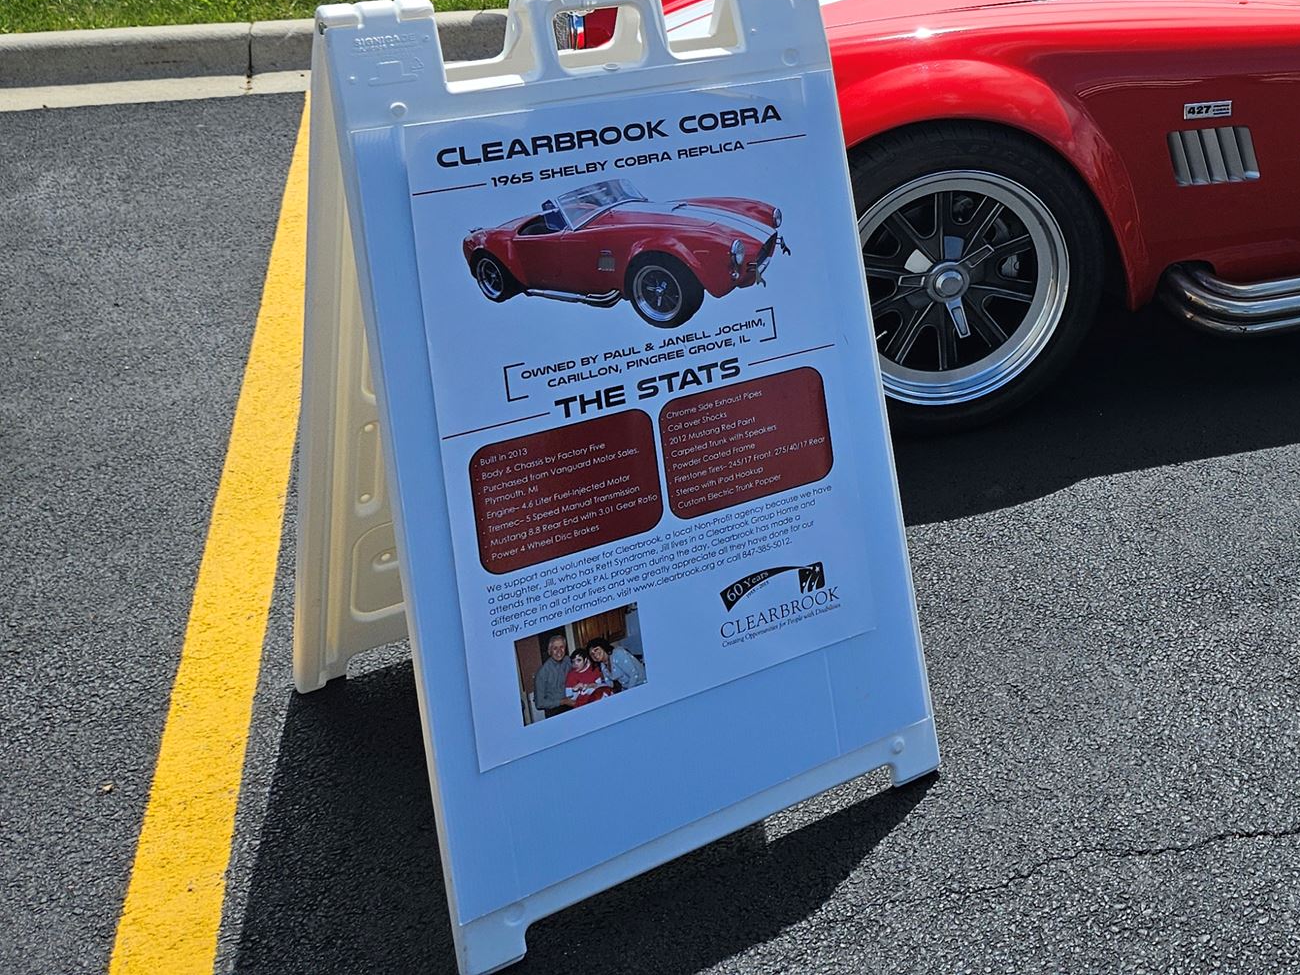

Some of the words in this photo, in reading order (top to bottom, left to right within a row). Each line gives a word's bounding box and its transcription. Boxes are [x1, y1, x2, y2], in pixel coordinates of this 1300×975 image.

[1188, 105, 1211, 115] 427
[436, 119, 669, 167] CLEARBROOK
[678, 104, 781, 133] COBRA
[491, 171, 534, 187] 1965
[539, 160, 608, 180] SHELBY
[614, 151, 672, 168] COBRA
[677, 140, 744, 159] REPLICA
[521, 360, 576, 379] OWNED
[580, 354, 598, 366] BY
[603, 346, 641, 361] PAUL
[644, 342, 654, 351] &
[658, 330, 711, 349] JANELL
[714, 318, 765, 336] JOCHIM,
[547, 364, 622, 387] CARILLON,
[626, 348, 684, 370] PINGREE
[688, 337, 735, 354] GROVE,
[739, 334, 751, 343] IL
[554, 384, 626, 418] THE
[636, 357, 740, 400] STATS
[666, 407, 696, 419] Chrome
[697, 402, 713, 411] Side
[714, 394, 741, 407] Exhaust
[743, 390, 762, 399] Pipes
[667, 422, 682, 432] Coil
[683, 418, 701, 428] over
[701, 412, 727, 423] Shocks
[669, 434, 686, 445] 2012
[688, 426, 720, 440] Mustang
[720, 421, 736, 431] Red
[737, 416, 755, 427] Paint
[670, 442, 707, 457] Carpeted
[708, 436, 727, 447] Trunk
[728, 433, 743, 441] with
[744, 424, 776, 438] Speakers
[479, 455, 496, 466] Built
[498, 453, 506, 461] in
[507, 447, 527, 458] 2013
[481, 468, 503, 480] Body
[513, 457, 543, 471] Chassis
[544, 455, 556, 463] by
[557, 447, 587, 460] Factory
[589, 443, 605, 451] Five
[483, 475, 528, 493] Purchased
[529, 471, 549, 481] from
[550, 458, 591, 475] Vanguard
[592, 453, 616, 464] Motor
[672, 457, 701, 470] Powder
[702, 448, 731, 462] Coated
[732, 443, 755, 454] Frame
[674, 470, 707, 483] Firestone
[808, 436, 825, 445] Rear
[521, 499, 533, 508] 4.6
[535, 495, 552, 505] Liter
[553, 480, 605, 500] Fuel-Injected
[606, 474, 630, 486] Motor
[527, 484, 538, 494] MI
[675, 485, 699, 496] Stereo
[700, 479, 716, 488] with
[717, 474, 734, 484] iPod
[735, 466, 763, 479] Hookup
[677, 496, 706, 509] Custom
[707, 487, 734, 500] Electric
[735, 481, 753, 492] Trunk
[754, 474, 781, 486] Popper
[490, 531, 527, 546] Mustang
[528, 526, 541, 535] 8.8
[542, 521, 561, 532] Rear
[562, 515, 578, 526] End
[580, 511, 597, 520] with
[615, 500, 636, 510] Gear
[637, 494, 657, 504] Ratio
[526, 514, 530, 522] 5
[532, 507, 560, 521] Speed
[561, 497, 592, 512] Manual
[593, 485, 639, 503] Transmission
[486, 584, 502, 593] We
[503, 572, 537, 589] support
[539, 565, 558, 577] and
[559, 554, 601, 571] volunteer
[602, 550, 613, 558] for
[672, 525, 692, 537] local
[694, 513, 732, 531] Non-Profit
[734, 505, 764, 519] agency
[765, 495, 798, 509] because
[812, 485, 832, 495] have
[491, 547, 518, 560] Power
[527, 536, 553, 549] Wheel
[554, 532, 572, 542] Disc
[573, 524, 599, 537] Brakes
[557, 572, 577, 582] who
[578, 567, 594, 577] has
[595, 560, 612, 571] Rett
[660, 542, 669, 552] Jill
[670, 538, 688, 548] lives
[688, 535, 696, 543] in
[705, 519, 749, 537] Clearbrook
[750, 512, 775, 524] Group
[776, 505, 799, 516] Home
[800, 498, 815, 509] and
[492, 624, 522, 637] family.
[523, 618, 537, 628] For
[539, 610, 563, 623] more
[616, 587, 631, 597] visit
[632, 562, 715, 592] www.clearbrook.org
[716, 558, 725, 566] or
[726, 552, 741, 563] call
[726, 583, 743, 602] 60
[743, 571, 769, 587] Years
[720, 586, 840, 639] CLEARBROOK
